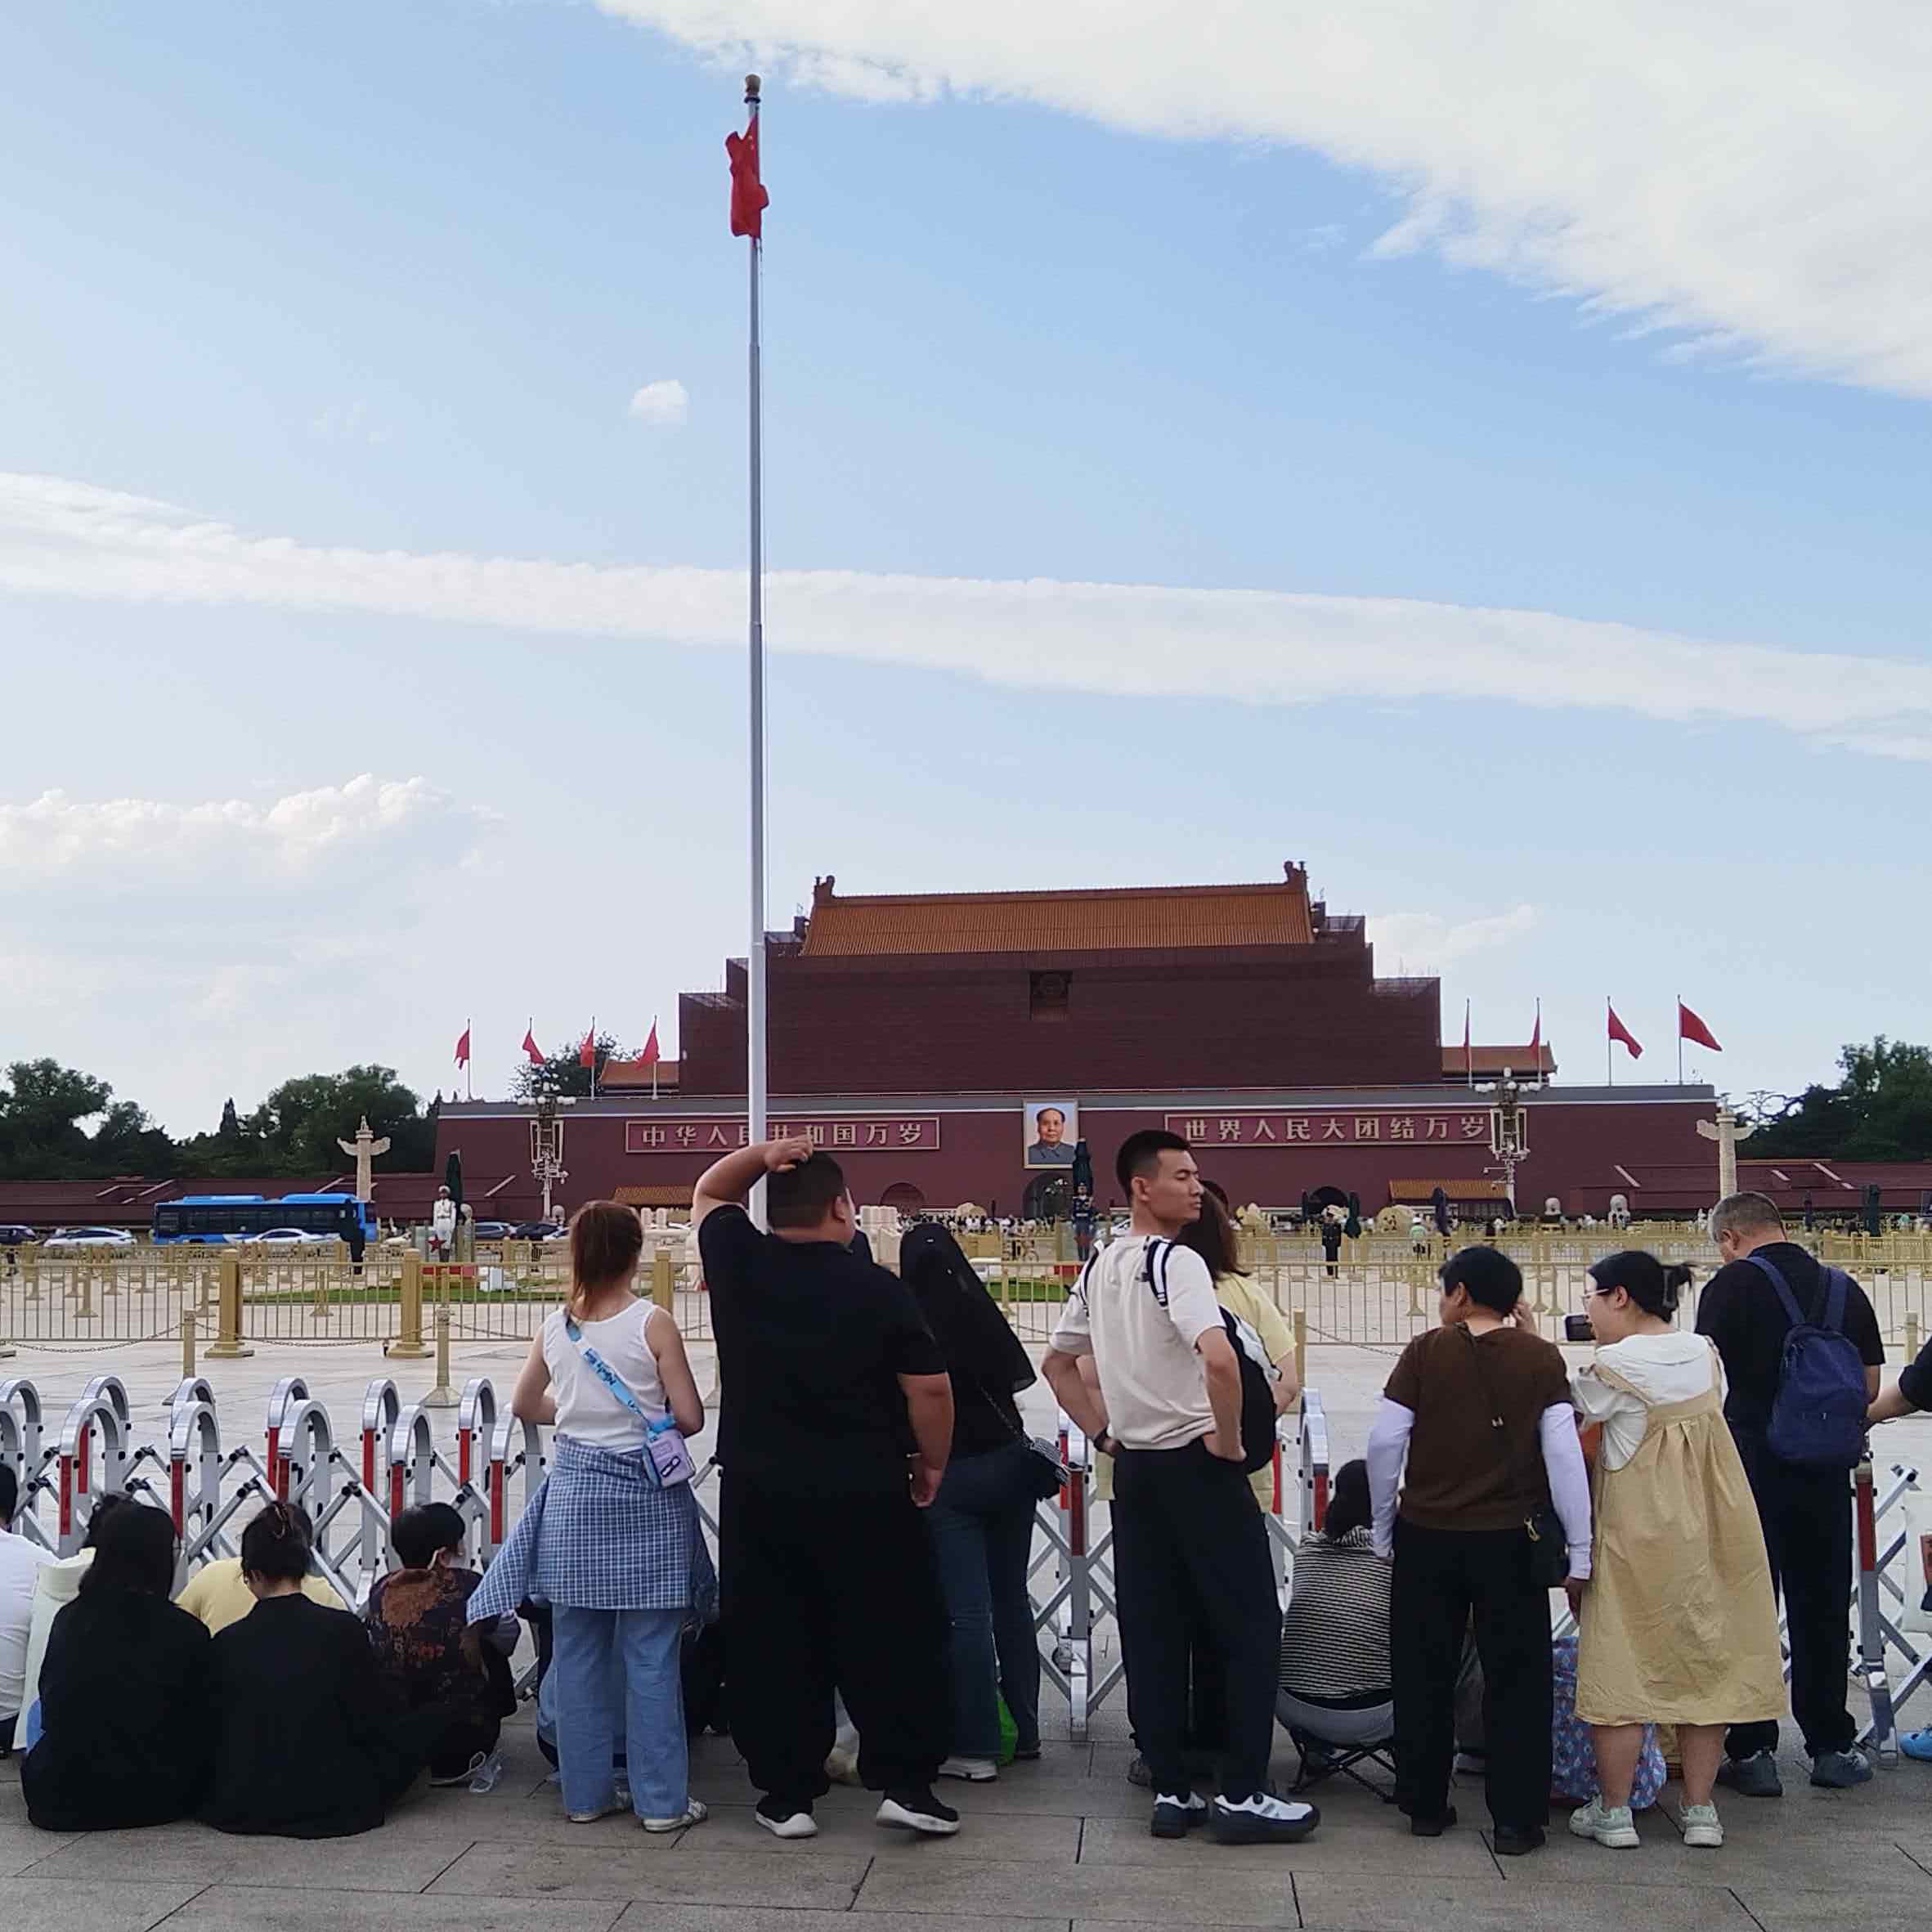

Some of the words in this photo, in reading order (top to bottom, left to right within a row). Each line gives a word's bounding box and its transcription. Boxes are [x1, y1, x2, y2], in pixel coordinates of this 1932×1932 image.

[1183, 1116, 1486, 1141] 世界人民大团结万岁
